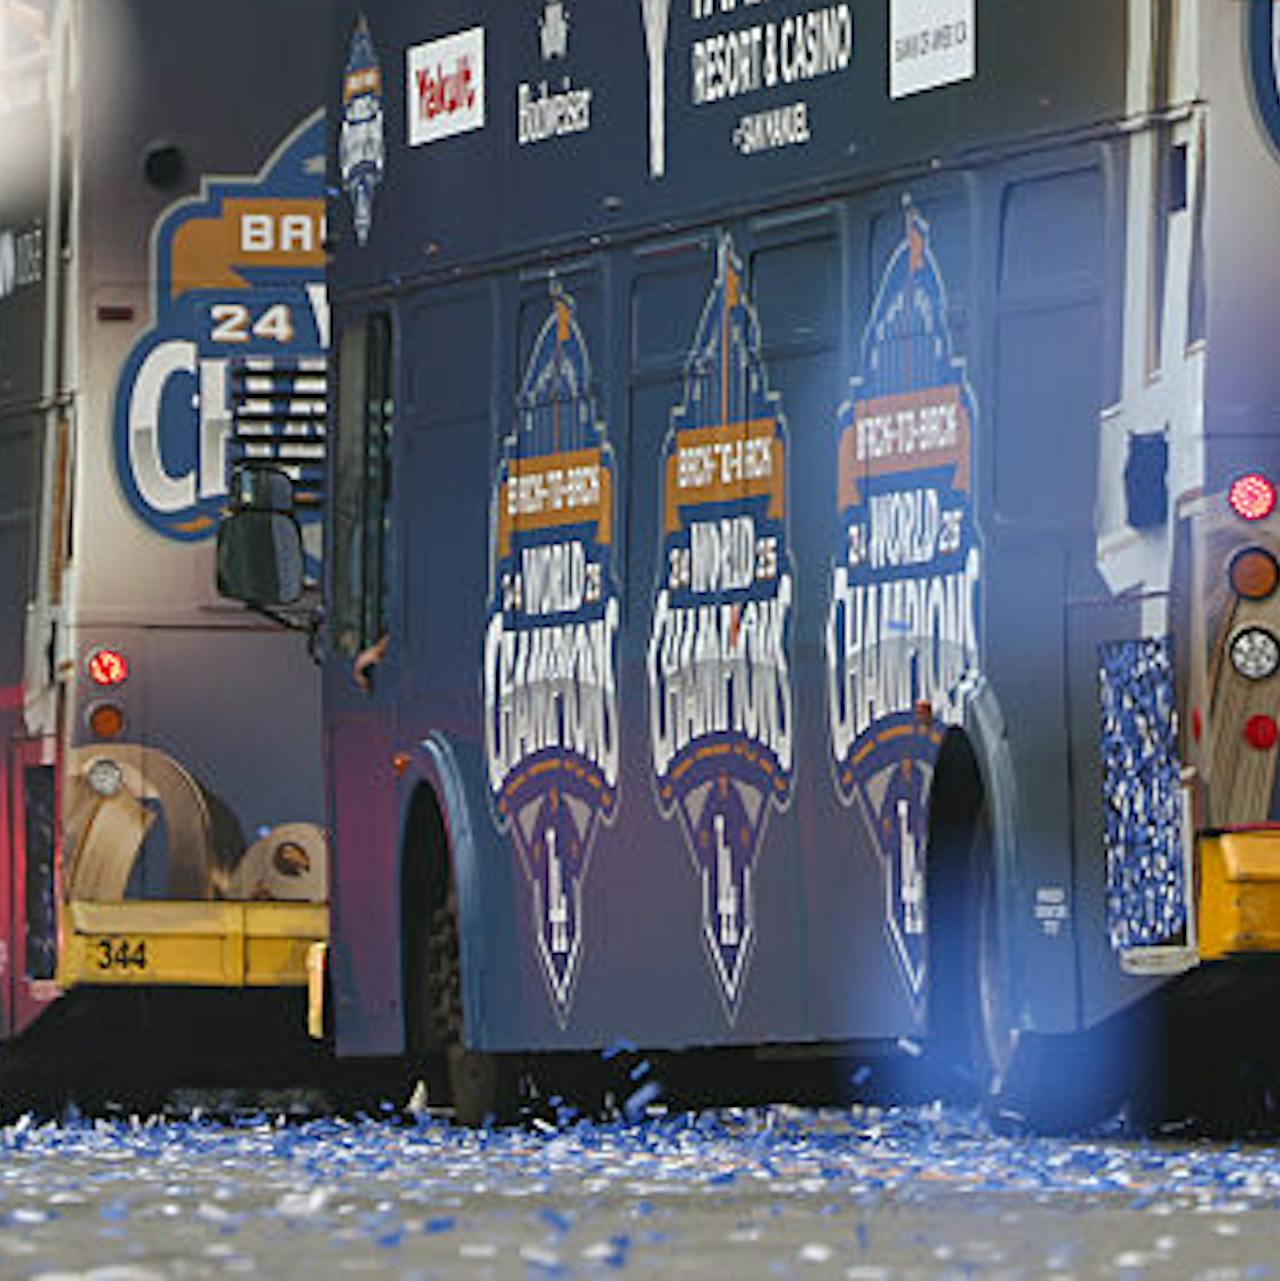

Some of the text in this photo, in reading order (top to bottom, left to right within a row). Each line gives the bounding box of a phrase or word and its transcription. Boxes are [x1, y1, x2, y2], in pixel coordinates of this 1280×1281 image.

[693, 26, 762, 105] RESORT
[780, 3, 853, 85] CASINO
[209, 303, 295, 344] 24
[691, 517, 755, 593] WORLD
[870, 488, 939, 570] WORLD
[522, 540, 586, 615] WORLD
[484, 597, 620, 793] CHAMPIONS
[649, 574, 792, 777] CHAMPIONS
[826, 547, 980, 762] CHAMPIONS
[98, 939, 147, 970] 344
